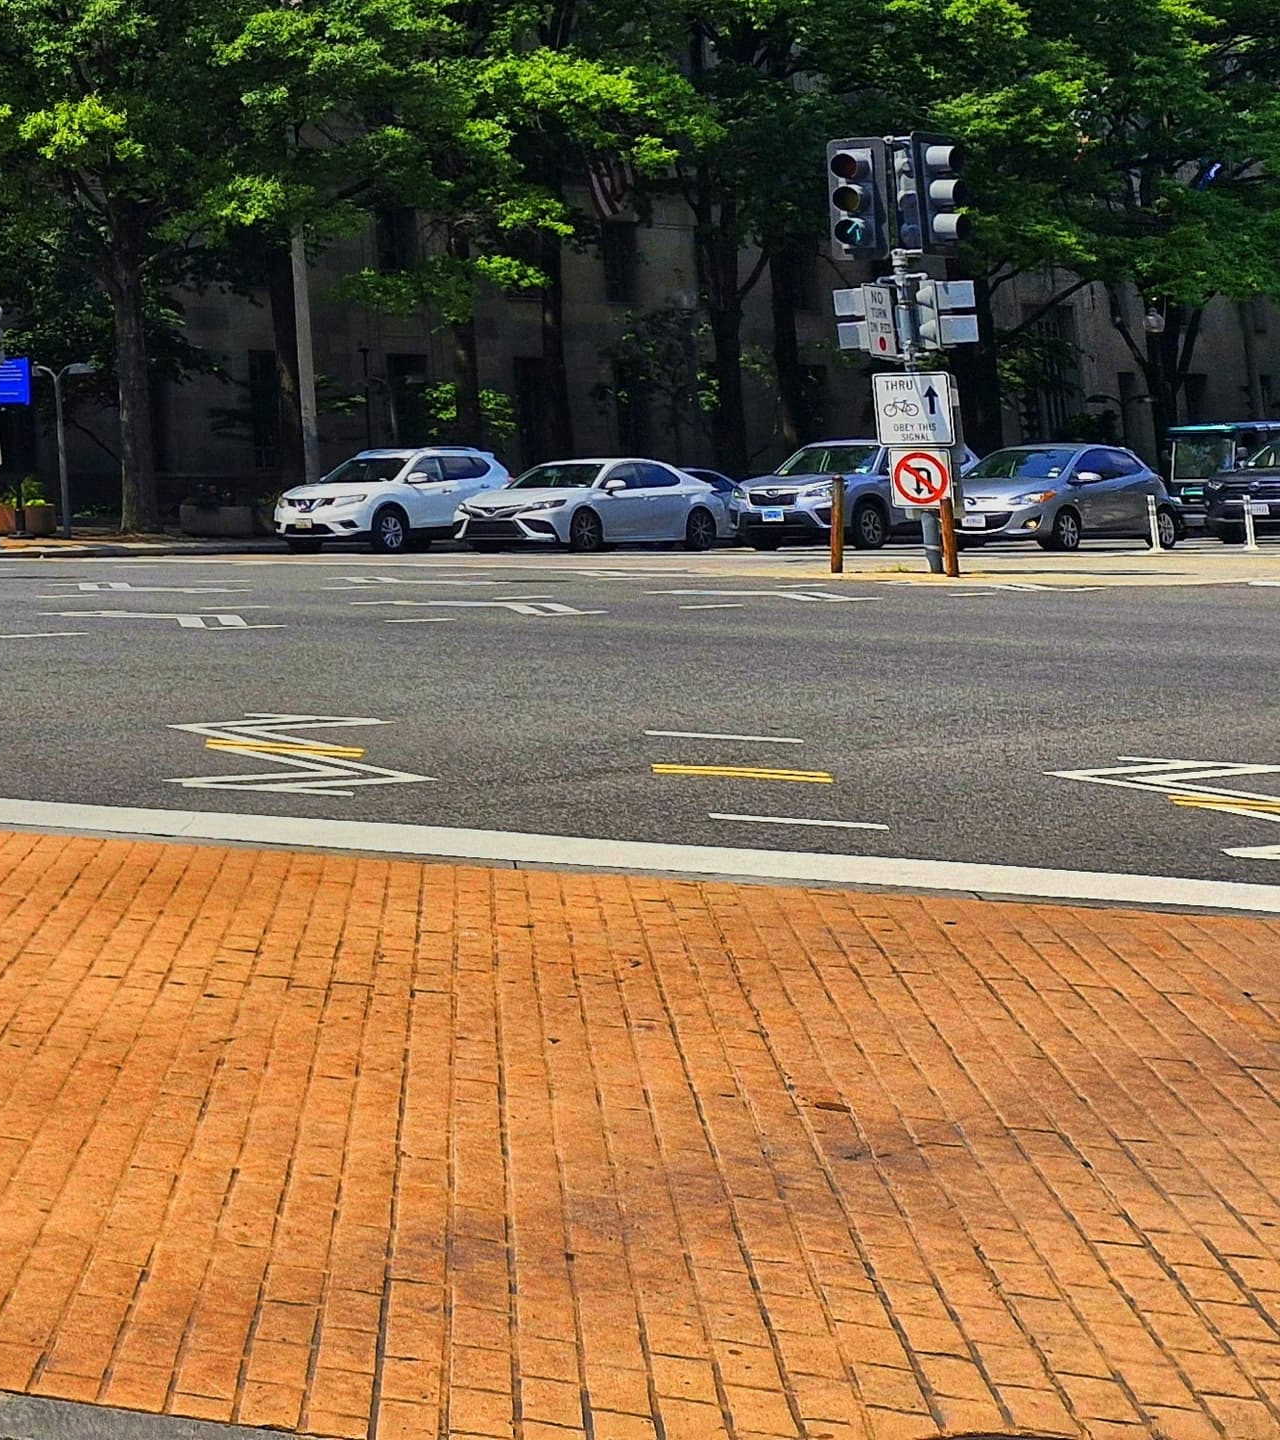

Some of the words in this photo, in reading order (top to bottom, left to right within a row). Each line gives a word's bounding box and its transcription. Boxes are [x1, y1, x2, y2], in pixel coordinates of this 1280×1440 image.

[870, 290, 884, 305] NO
[884, 379, 913, 391] THRU
[893, 423, 914, 432] OBEY
[918, 422, 937, 432] THIS
[901, 433, 930, 442] SIGNAL
